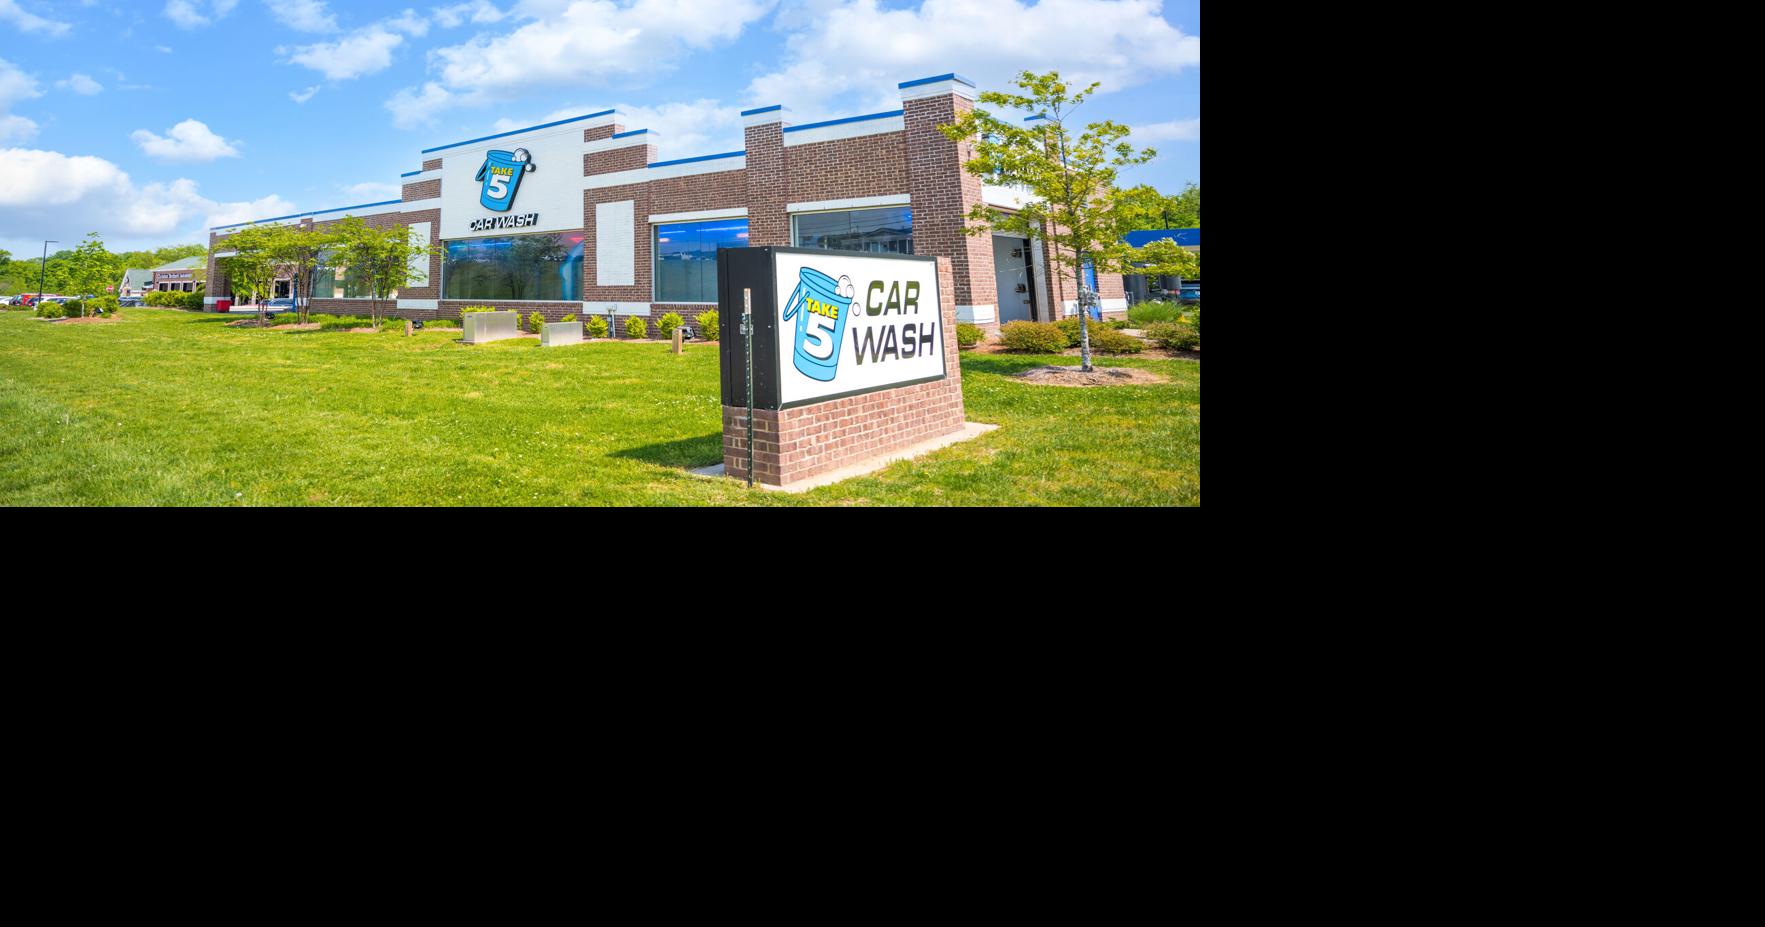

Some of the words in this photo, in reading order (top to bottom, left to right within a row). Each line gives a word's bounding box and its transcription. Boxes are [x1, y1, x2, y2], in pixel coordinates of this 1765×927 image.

[491, 166, 513, 176] TAKE
[487, 174, 510, 199] 5
[469, 217, 495, 232] CAR
[495, 213, 539, 229] WASH
[805, 297, 839, 319] TAKE
[865, 280, 920, 316] CAR
[802, 315, 836, 360] 5
[852, 322, 935, 365] WASH
